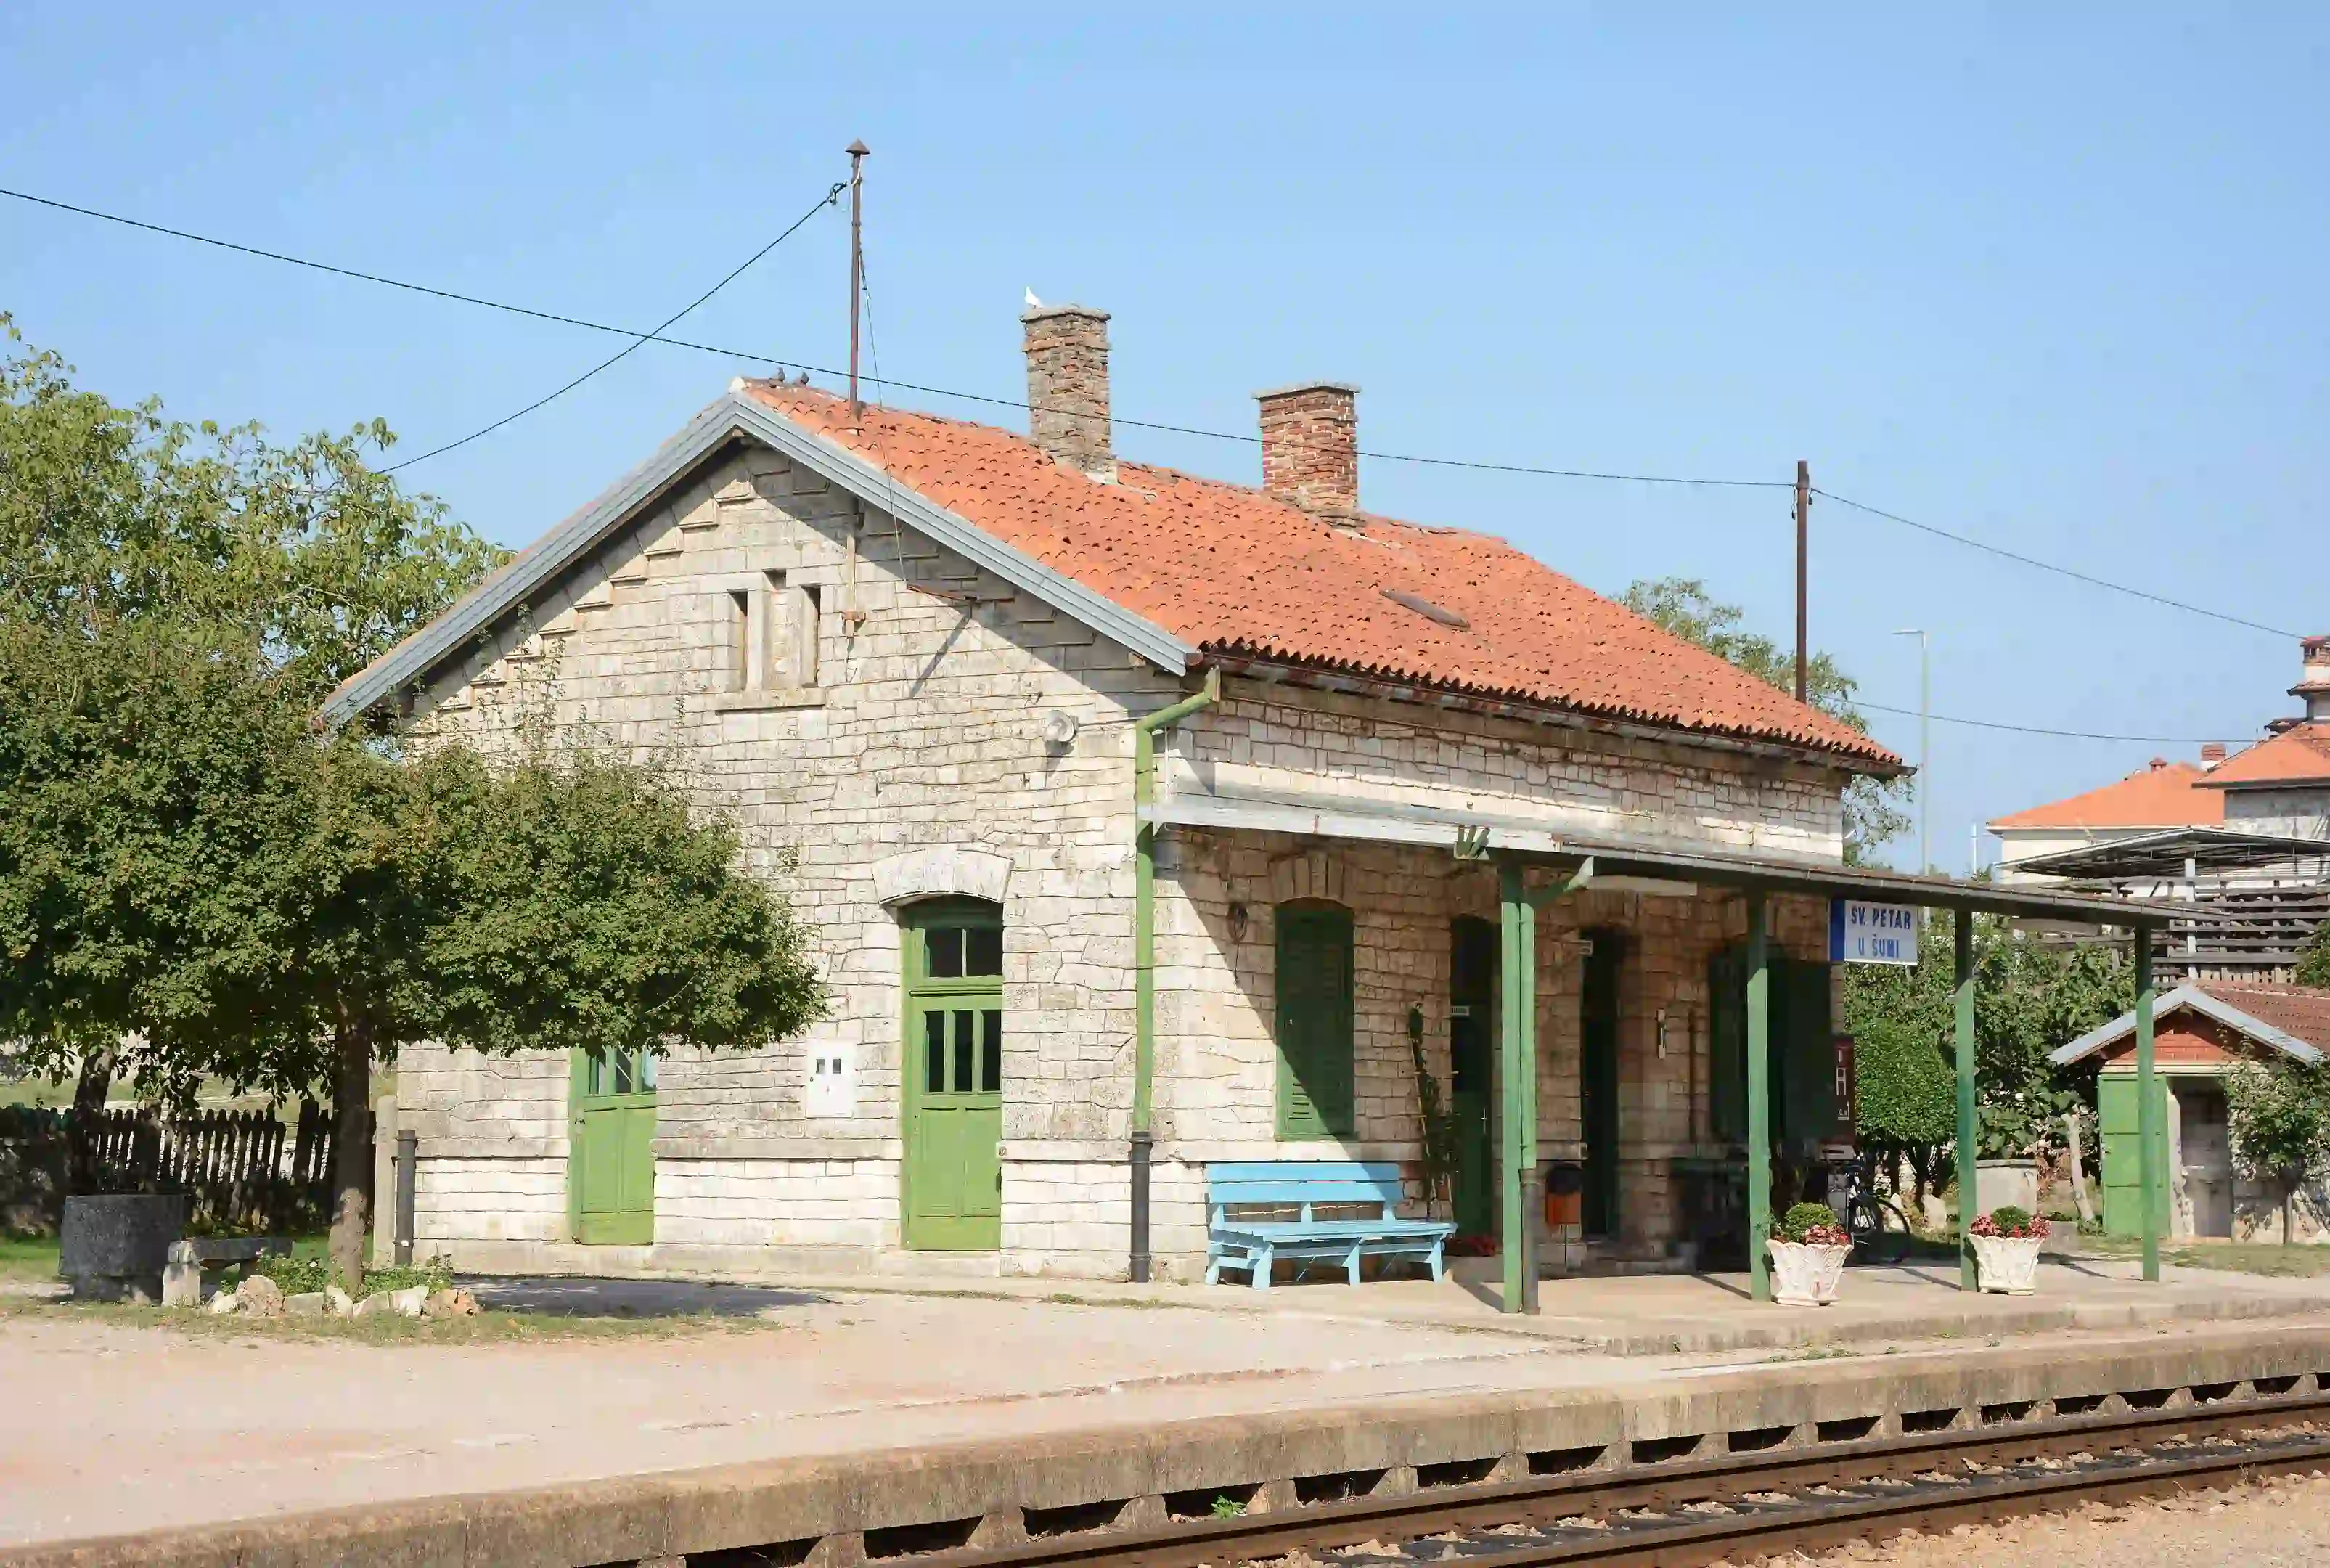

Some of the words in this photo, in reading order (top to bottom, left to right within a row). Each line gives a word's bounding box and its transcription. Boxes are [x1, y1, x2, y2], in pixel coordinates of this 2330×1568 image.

[1851, 905, 1865, 926] SV.
[1872, 907, 1911, 930] PETAR
[1858, 937, 1865, 956] U
